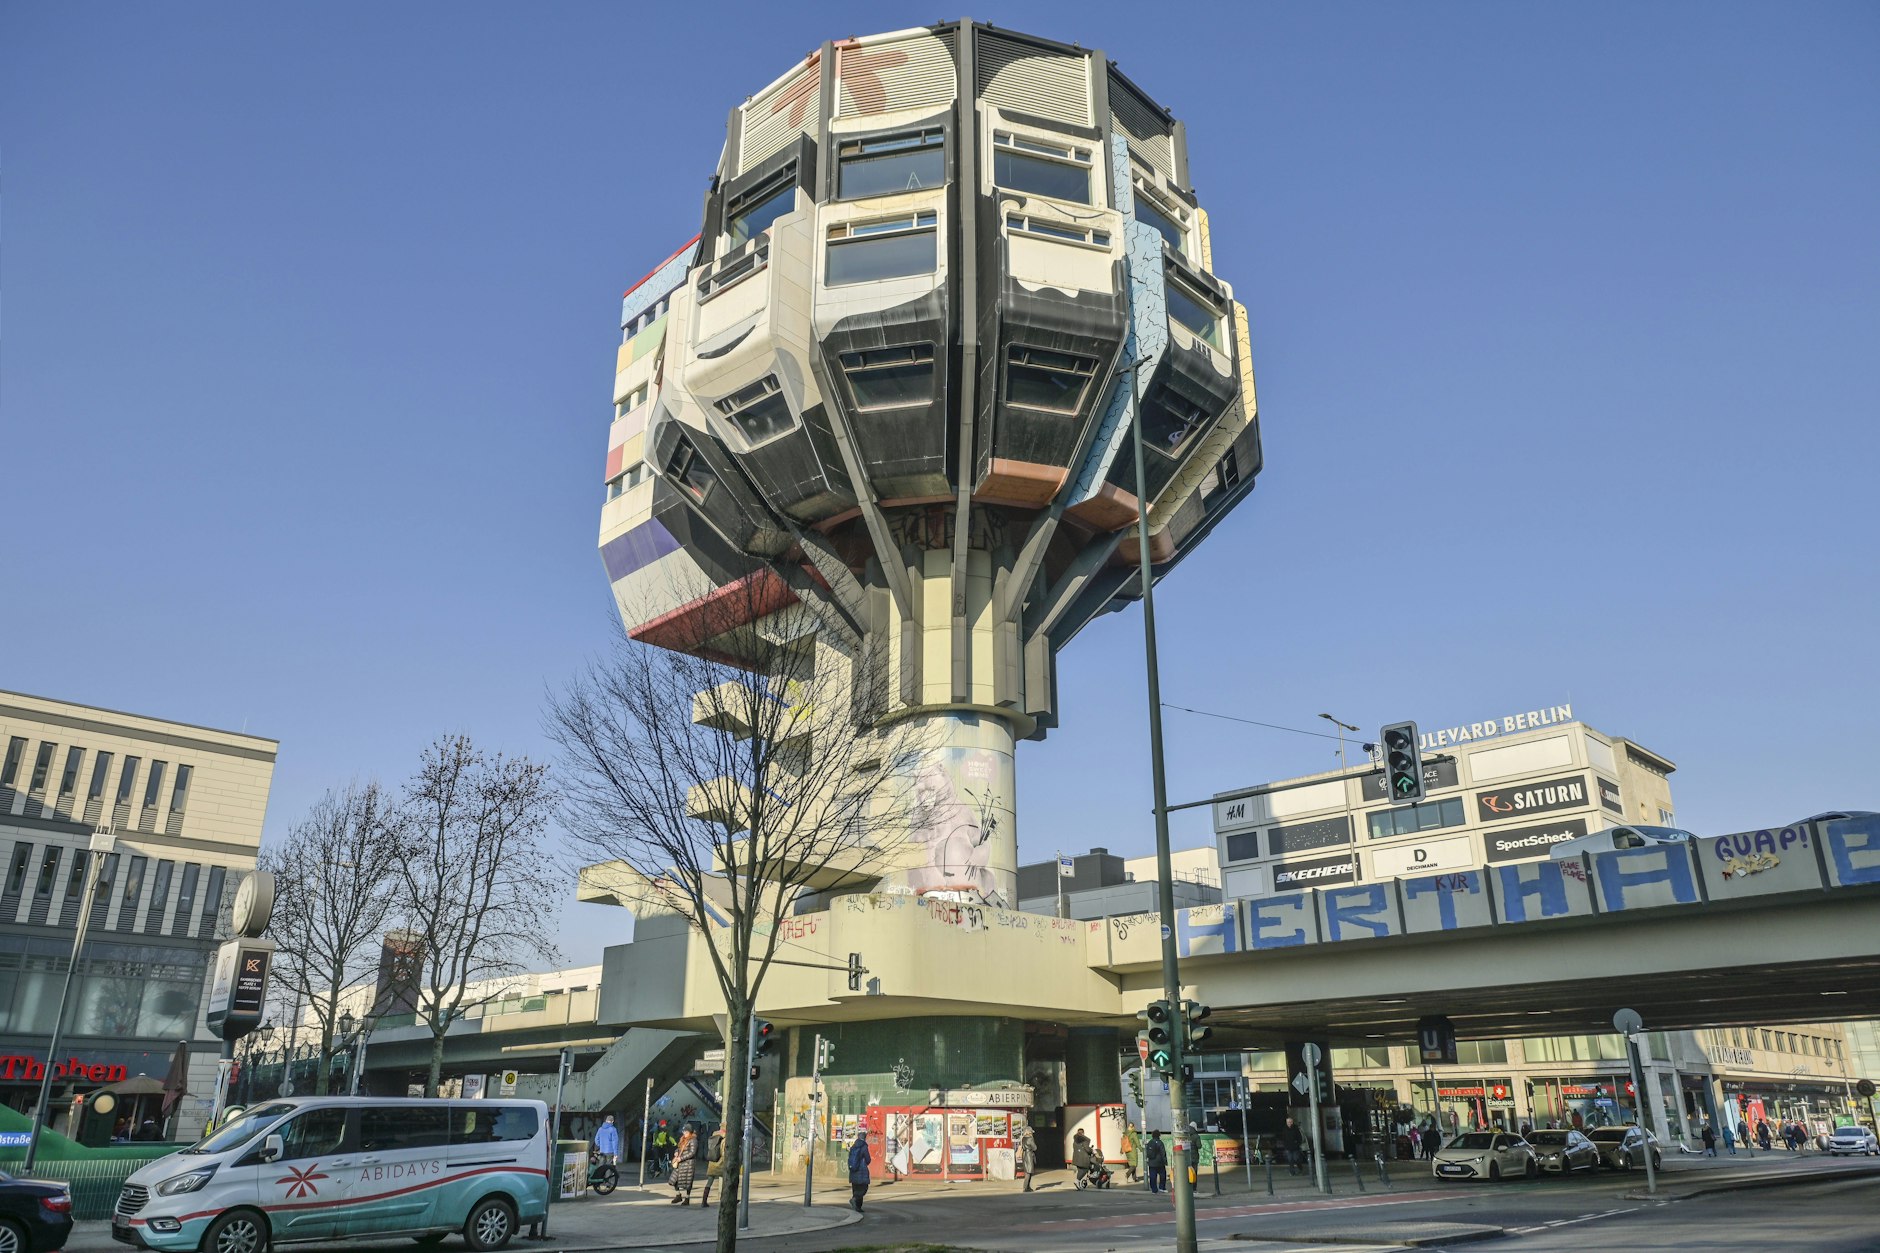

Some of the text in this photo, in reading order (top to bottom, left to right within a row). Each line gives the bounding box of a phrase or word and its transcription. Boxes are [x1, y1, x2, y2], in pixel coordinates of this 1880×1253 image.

[1369, 703, 1573, 762] BULEVARD BERLIN
[1513, 782, 1583, 810] SATURN
[1226, 803, 1245, 821] H&M
[1496, 830, 1575, 852] SportScheck
[1413, 848, 1427, 863] D
[1276, 862, 1358, 883] SKECHERS
[1406, 862, 1438, 871] DEICHMANN
[360, 1160, 440, 1182] ABIDAYS
